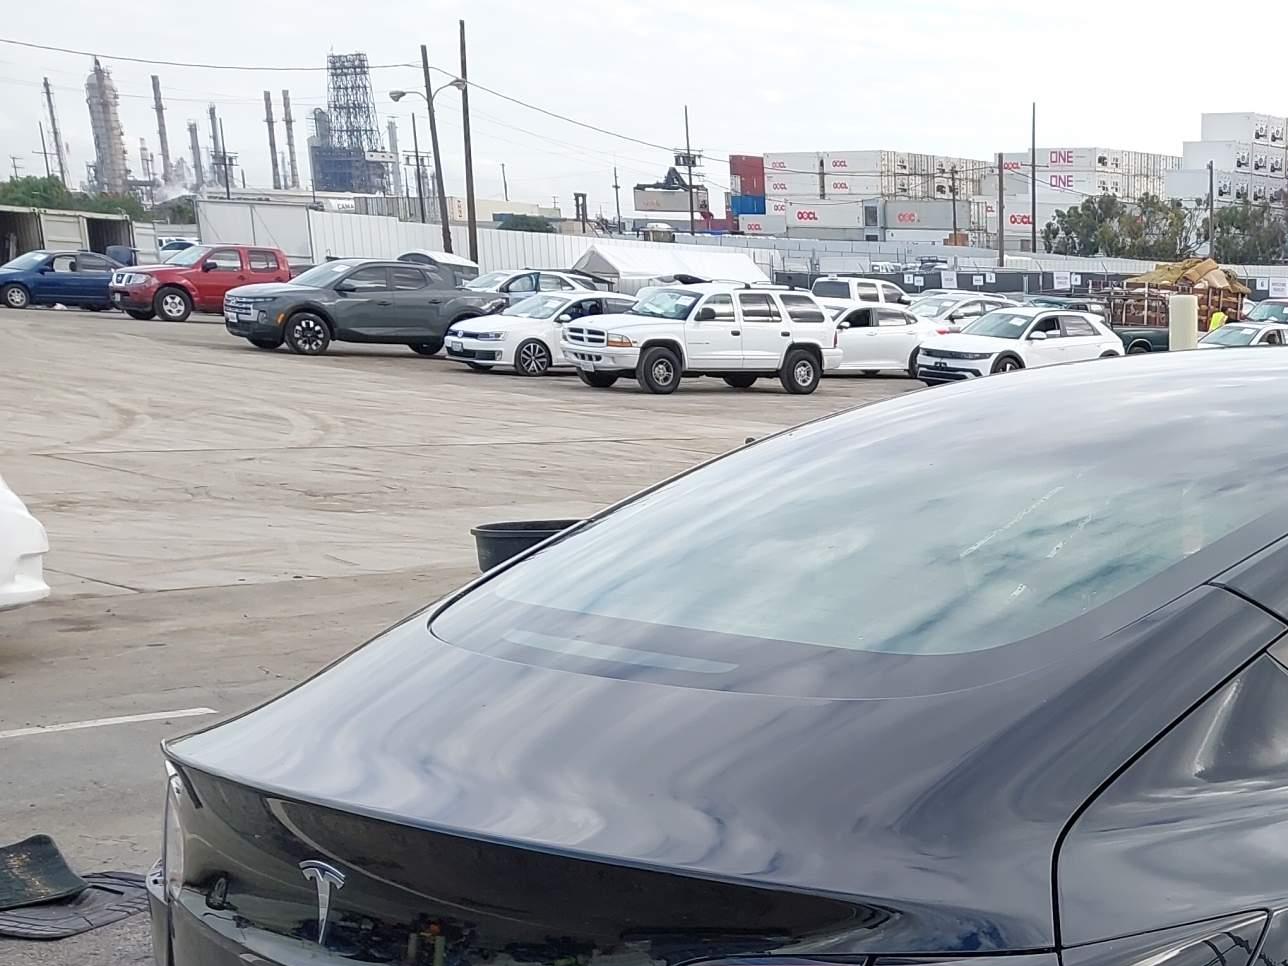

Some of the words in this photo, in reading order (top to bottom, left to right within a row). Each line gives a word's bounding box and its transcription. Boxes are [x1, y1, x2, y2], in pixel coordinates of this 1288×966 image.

[1050, 151, 1073, 163] ONE
[1050, 175, 1073, 187] ONE
[797, 211, 818, 221] OOCL
[1010, 214, 1033, 225] OOCL
